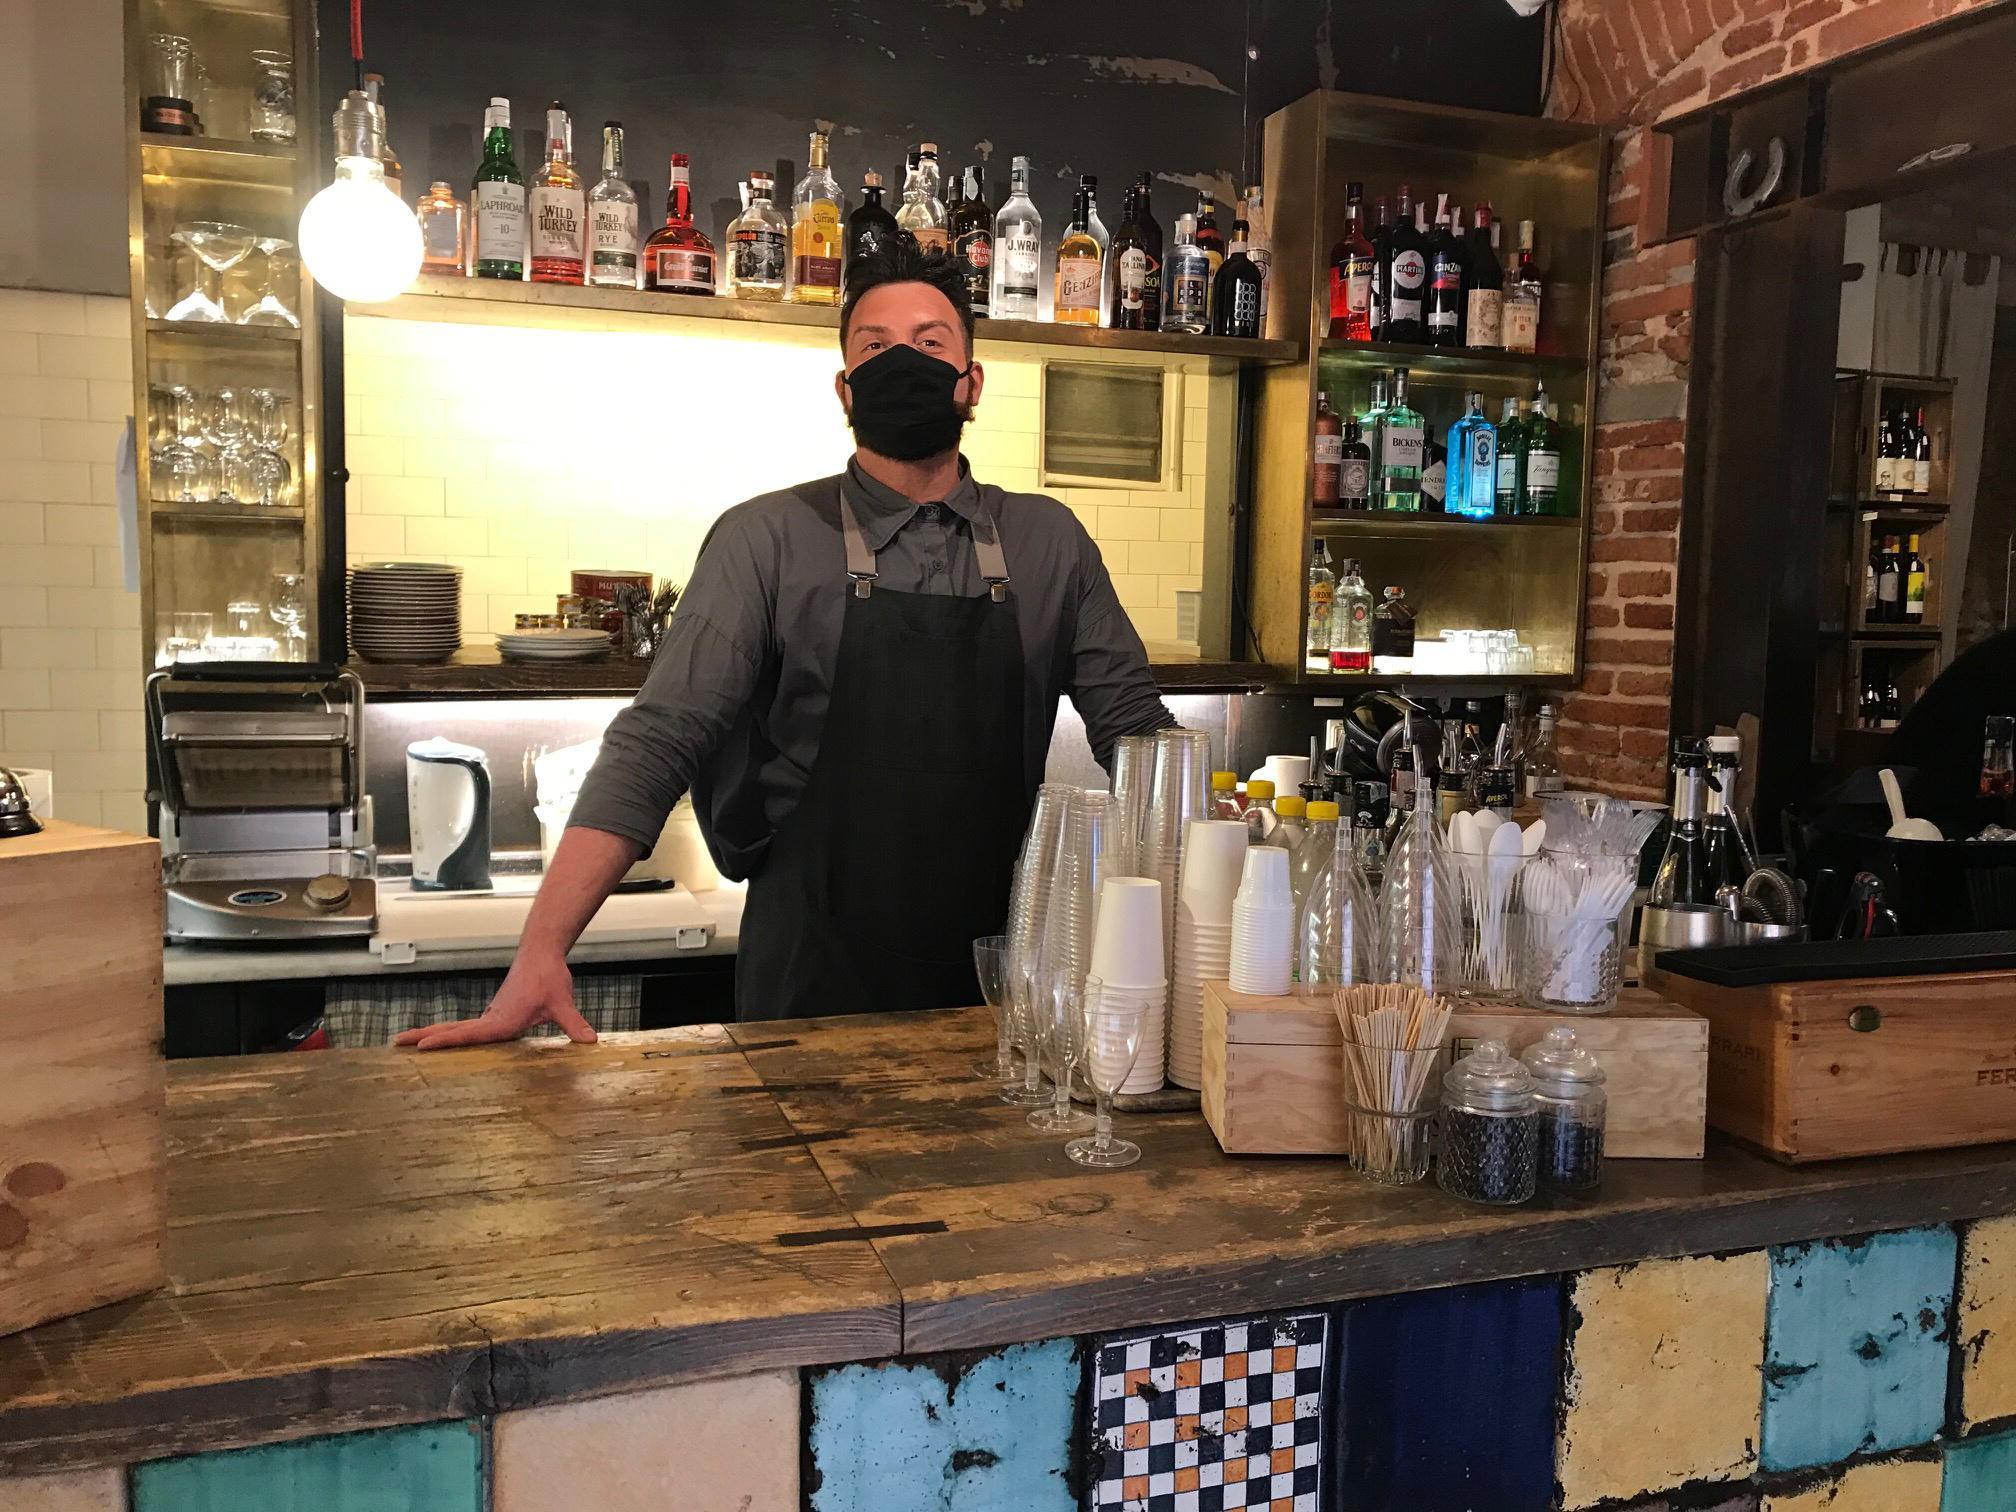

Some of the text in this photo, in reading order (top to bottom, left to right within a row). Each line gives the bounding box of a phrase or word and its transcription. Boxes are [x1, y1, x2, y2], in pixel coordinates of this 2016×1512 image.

[544, 205, 573, 219] WILD
[598, 212, 619, 222] WILD
[538, 215, 578, 232] TURKEY
[594, 220, 622, 231] TURKEY
[598, 235, 618, 243] RYE
[972, 253, 988, 263] Club
[1392, 437, 1422, 448] BICKENS
